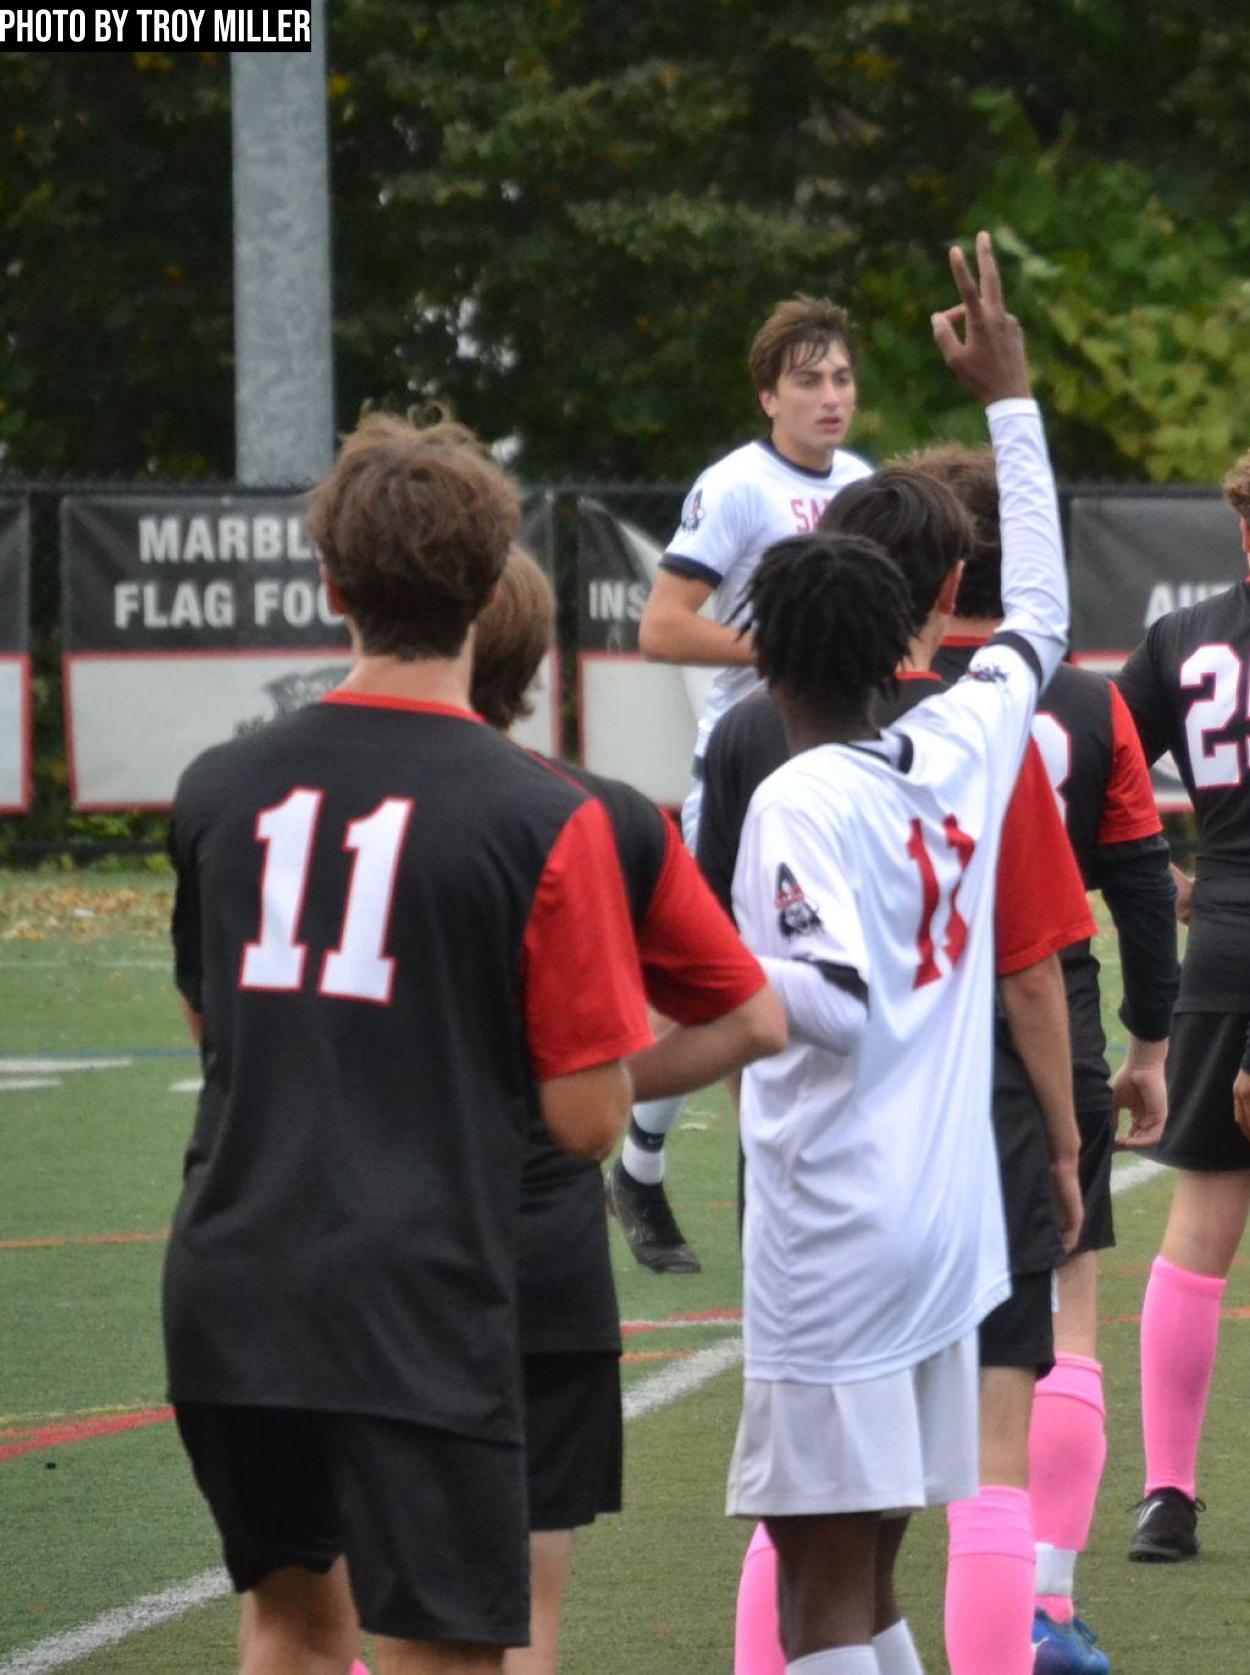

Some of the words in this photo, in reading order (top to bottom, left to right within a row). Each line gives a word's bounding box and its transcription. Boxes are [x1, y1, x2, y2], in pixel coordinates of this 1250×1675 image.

[138, 516, 323, 563] MARBL
[790, 499, 832, 534] SA
[115, 581, 234, 628] FLAG
[238, 783, 416, 1007] 11
[905, 813, 976, 990] 11
